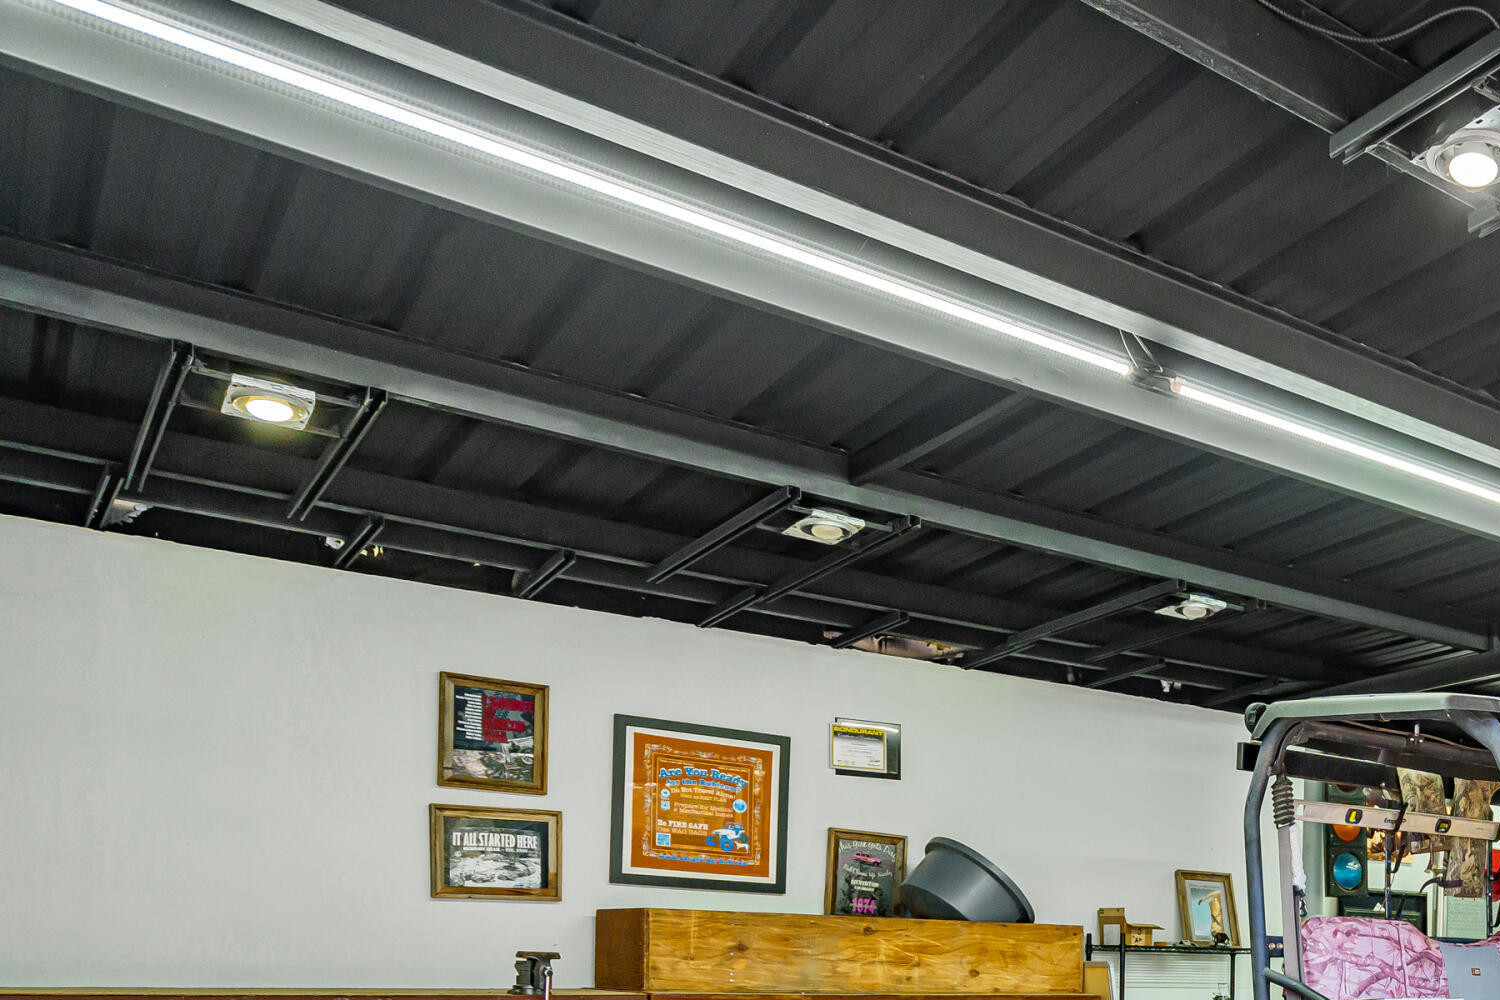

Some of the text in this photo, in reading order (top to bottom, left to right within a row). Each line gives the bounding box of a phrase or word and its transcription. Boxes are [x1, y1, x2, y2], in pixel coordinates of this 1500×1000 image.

[659, 768, 682, 778] Are
[683, 765, 709, 777] You
[710, 768, 749, 788] Ready
[668, 820, 688, 829] FIRE
[688, 822, 709, 831] SAFE
[452, 831, 538, 849] IT ALL STARTED HERE
